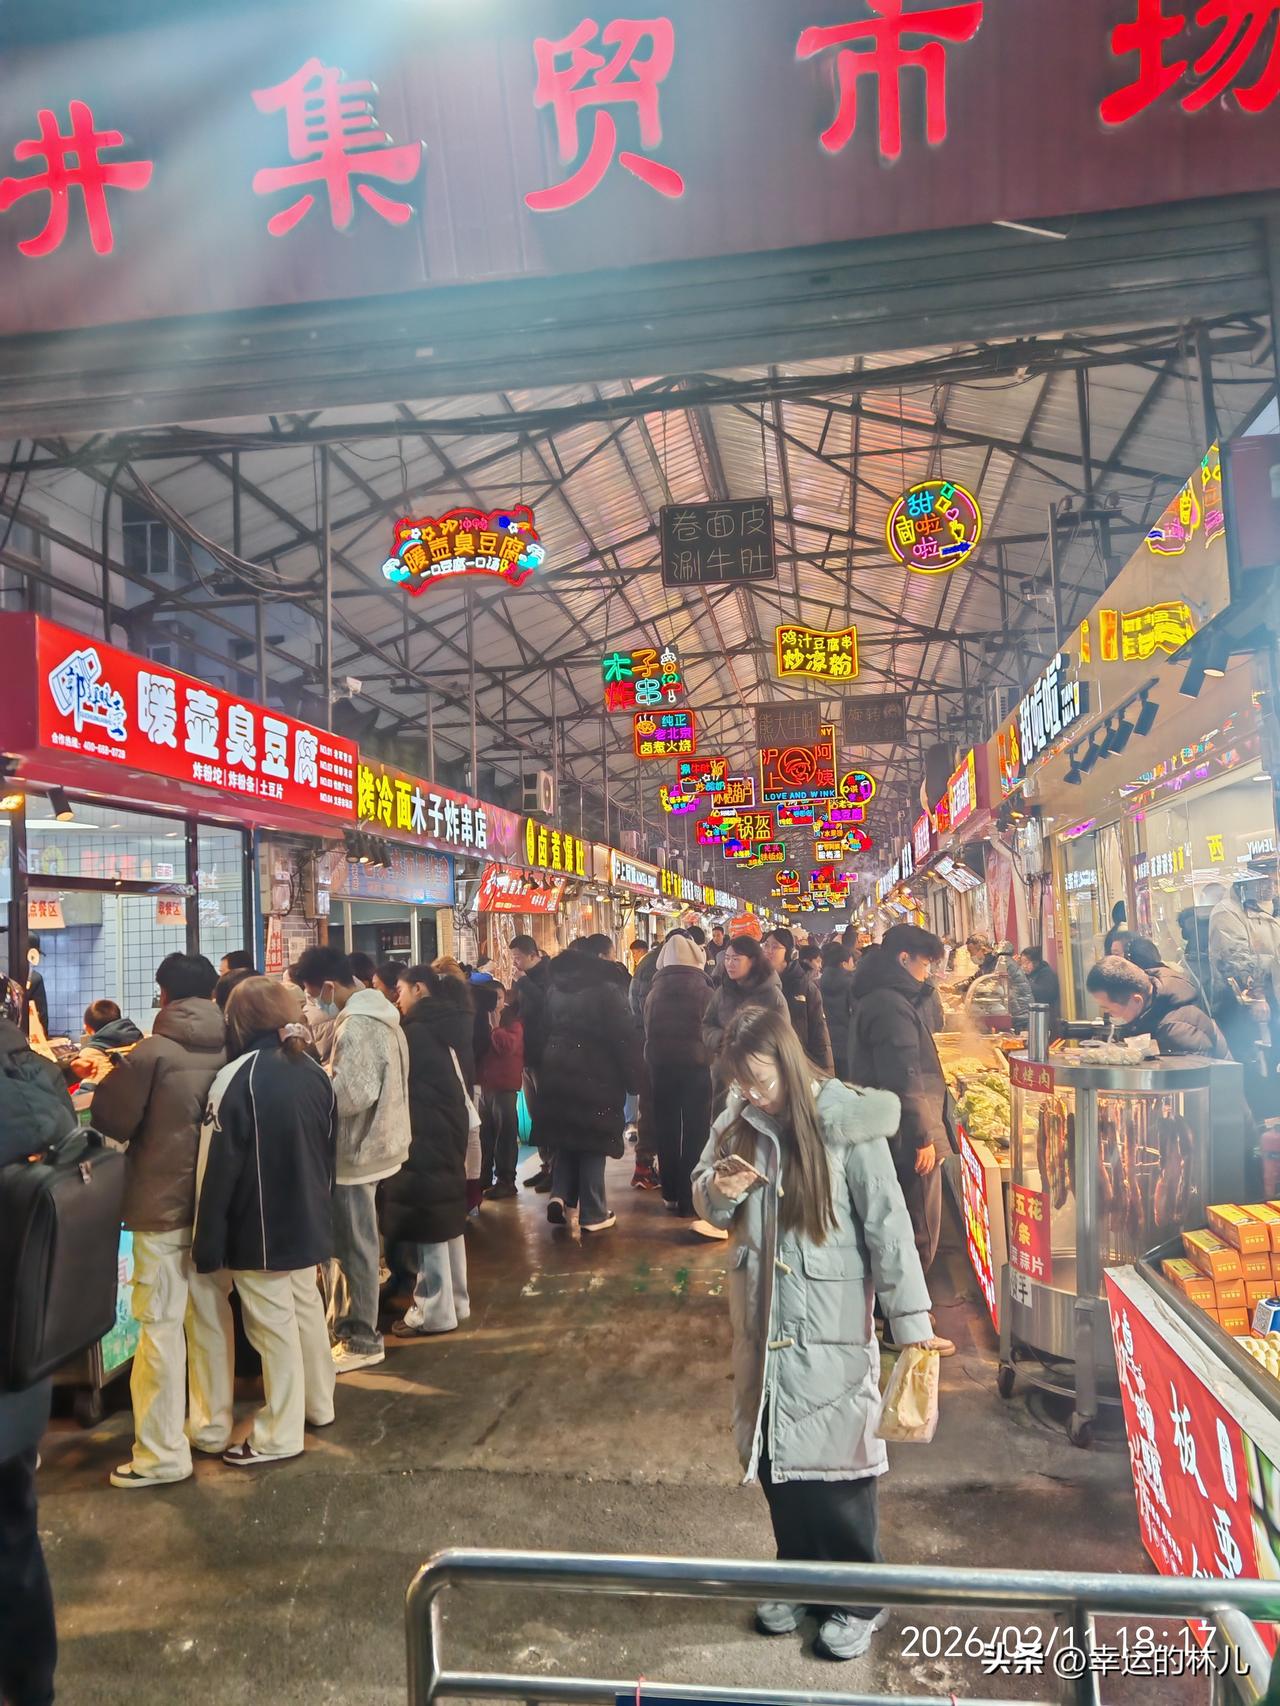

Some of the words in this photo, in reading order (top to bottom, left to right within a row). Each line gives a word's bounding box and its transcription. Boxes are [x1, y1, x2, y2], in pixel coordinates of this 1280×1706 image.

[0, 0, 1280, 257] 井集贸市场
[671, 504, 767, 541] 卷面皮
[403, 530, 525, 574] 暖壶臭豆腐
[671, 544, 772, 580] 涮牛肚
[781, 629, 853, 652] 鸡汁豆腐串
[603, 649, 659, 681] 木子
[782, 648, 853, 676] 炒凉粉
[604, 677, 662, 712] 炸串
[137, 670, 318, 789] 暖壶臭豆腐
[654, 726, 692, 740] 老北京
[661, 713, 687, 727] 纯正
[357, 764, 412, 831] 烤冷面
[411, 786, 487, 850] 木子炸串店
[765, 792, 787, 801] LOVE
[789, 791, 807, 800] AND
